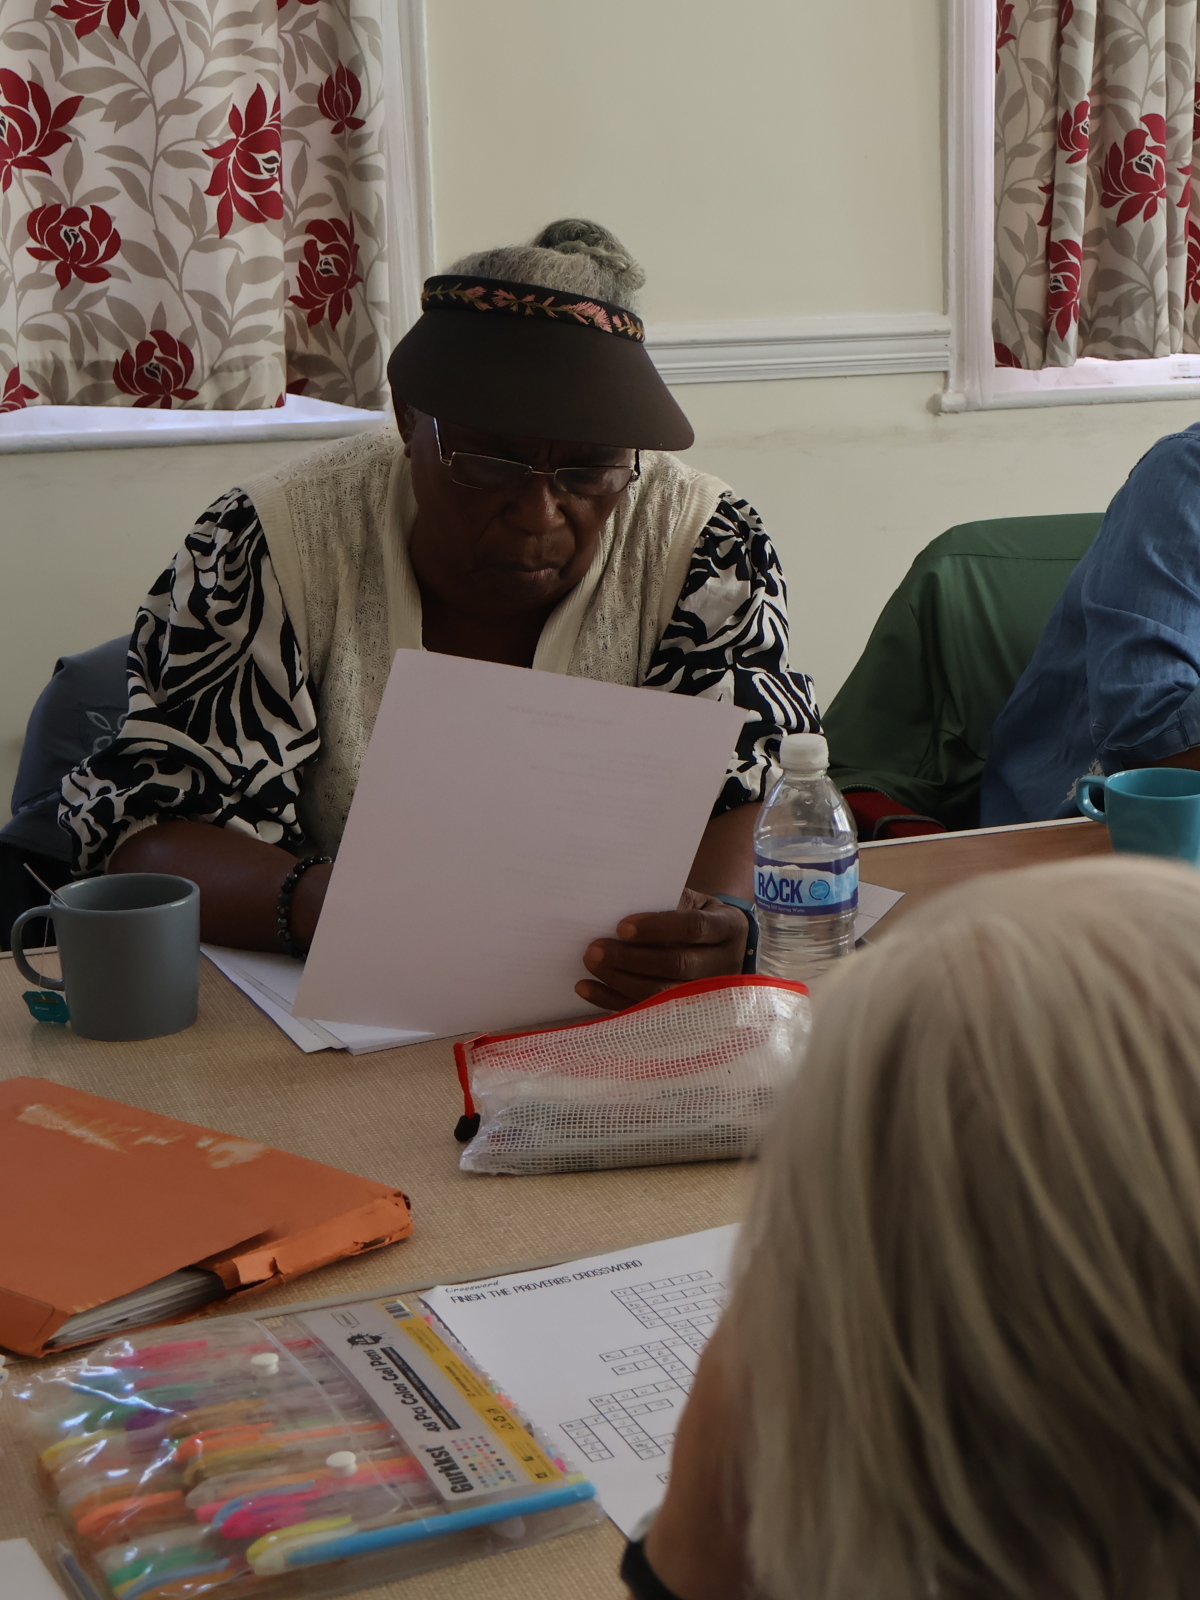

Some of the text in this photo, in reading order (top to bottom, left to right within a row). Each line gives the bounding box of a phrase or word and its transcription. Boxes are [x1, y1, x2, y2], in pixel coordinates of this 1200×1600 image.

[758, 871, 803, 904] ROCK
[445, 1280, 499, 1294] Crossword
[450, 1259, 643, 1304] FINISH THE PROVERBS CROSSWORD
[362, 1349, 388, 1366] Pens
[375, 1365, 400, 1383] Gel
[394, 1381, 420, 1406] Color
[411, 1405, 432, 1423] Pcs
[422, 1419, 442, 1434] 48
[424, 1445, 475, 1495] Gurkkst
